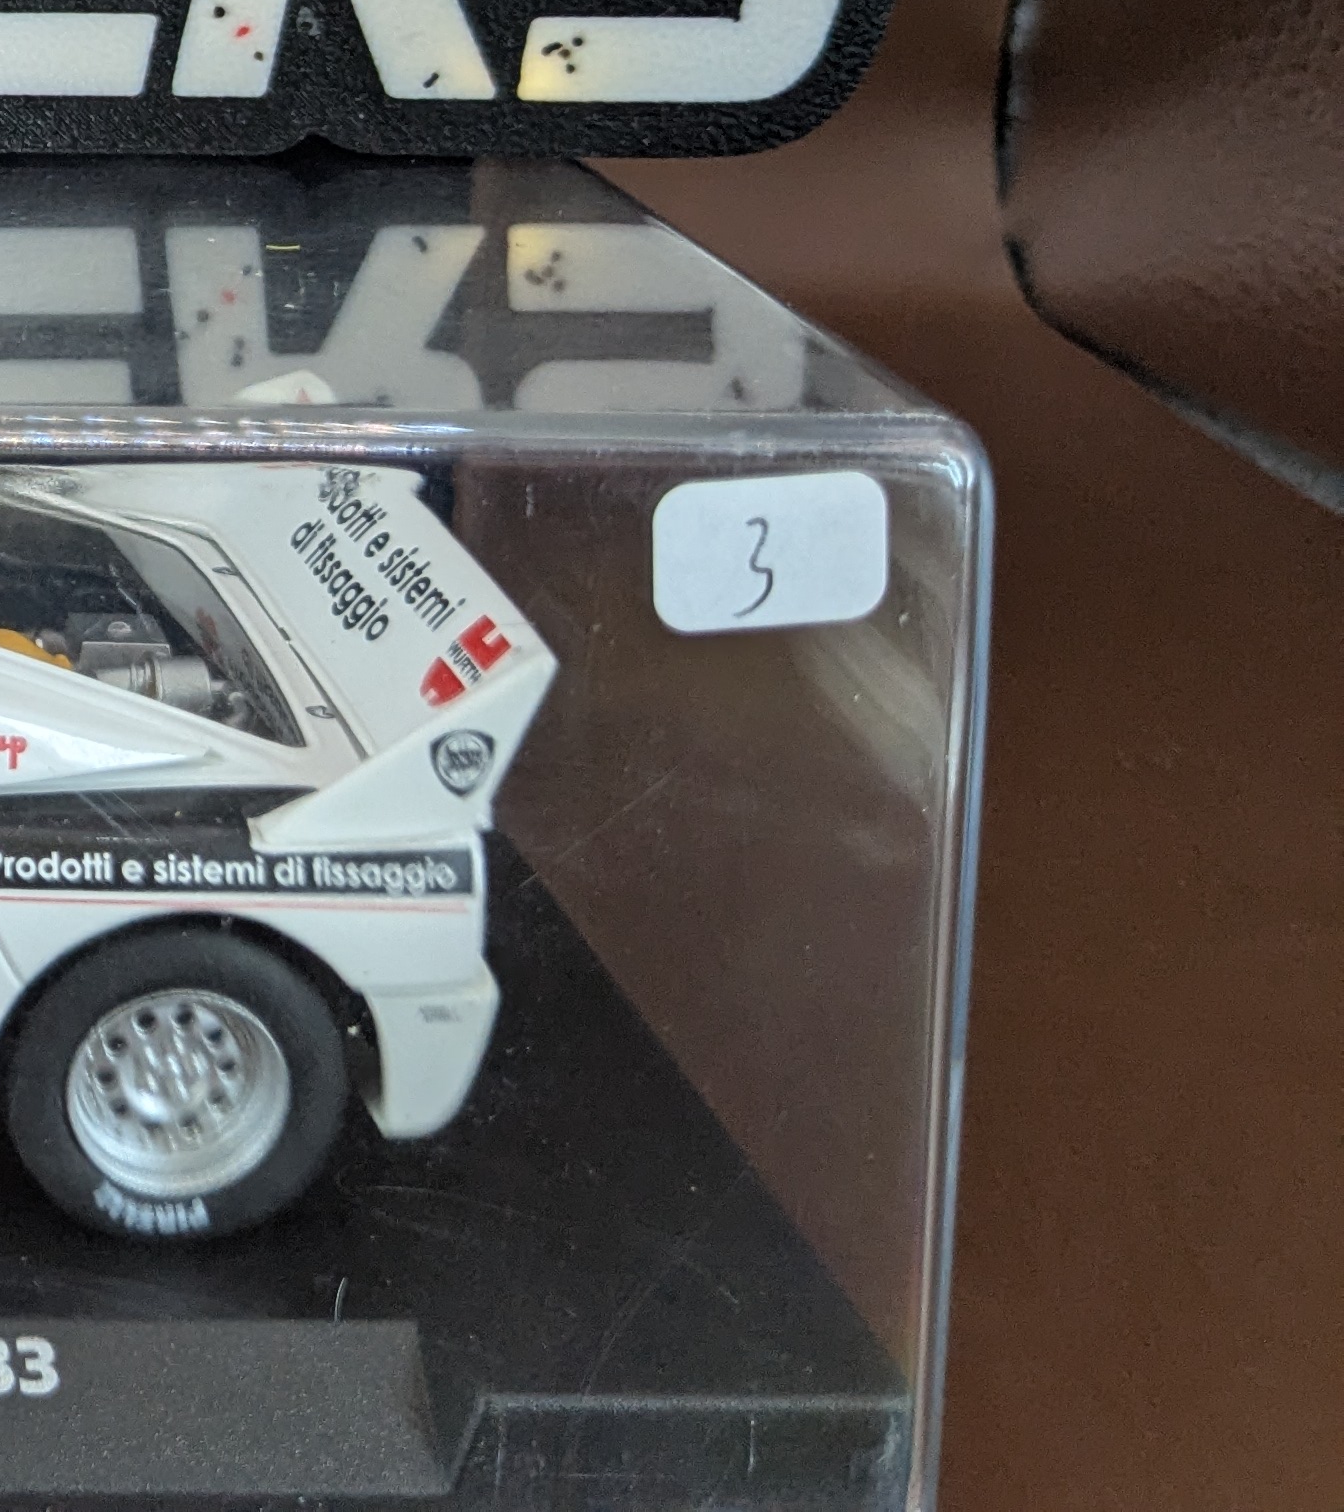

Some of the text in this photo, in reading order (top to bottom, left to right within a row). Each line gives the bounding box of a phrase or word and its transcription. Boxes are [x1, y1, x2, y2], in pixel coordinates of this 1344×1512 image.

[290, 518, 389, 641] di fissaggio
[364, 531, 390, 558] e
[377, 546, 467, 633] sistemi
[733, 516, 773, 617] 3
[121, 859, 145, 882] e
[154, 854, 266, 885] sistemi
[274, 855, 307, 886] di
[312, 856, 458, 895] fissaggio
